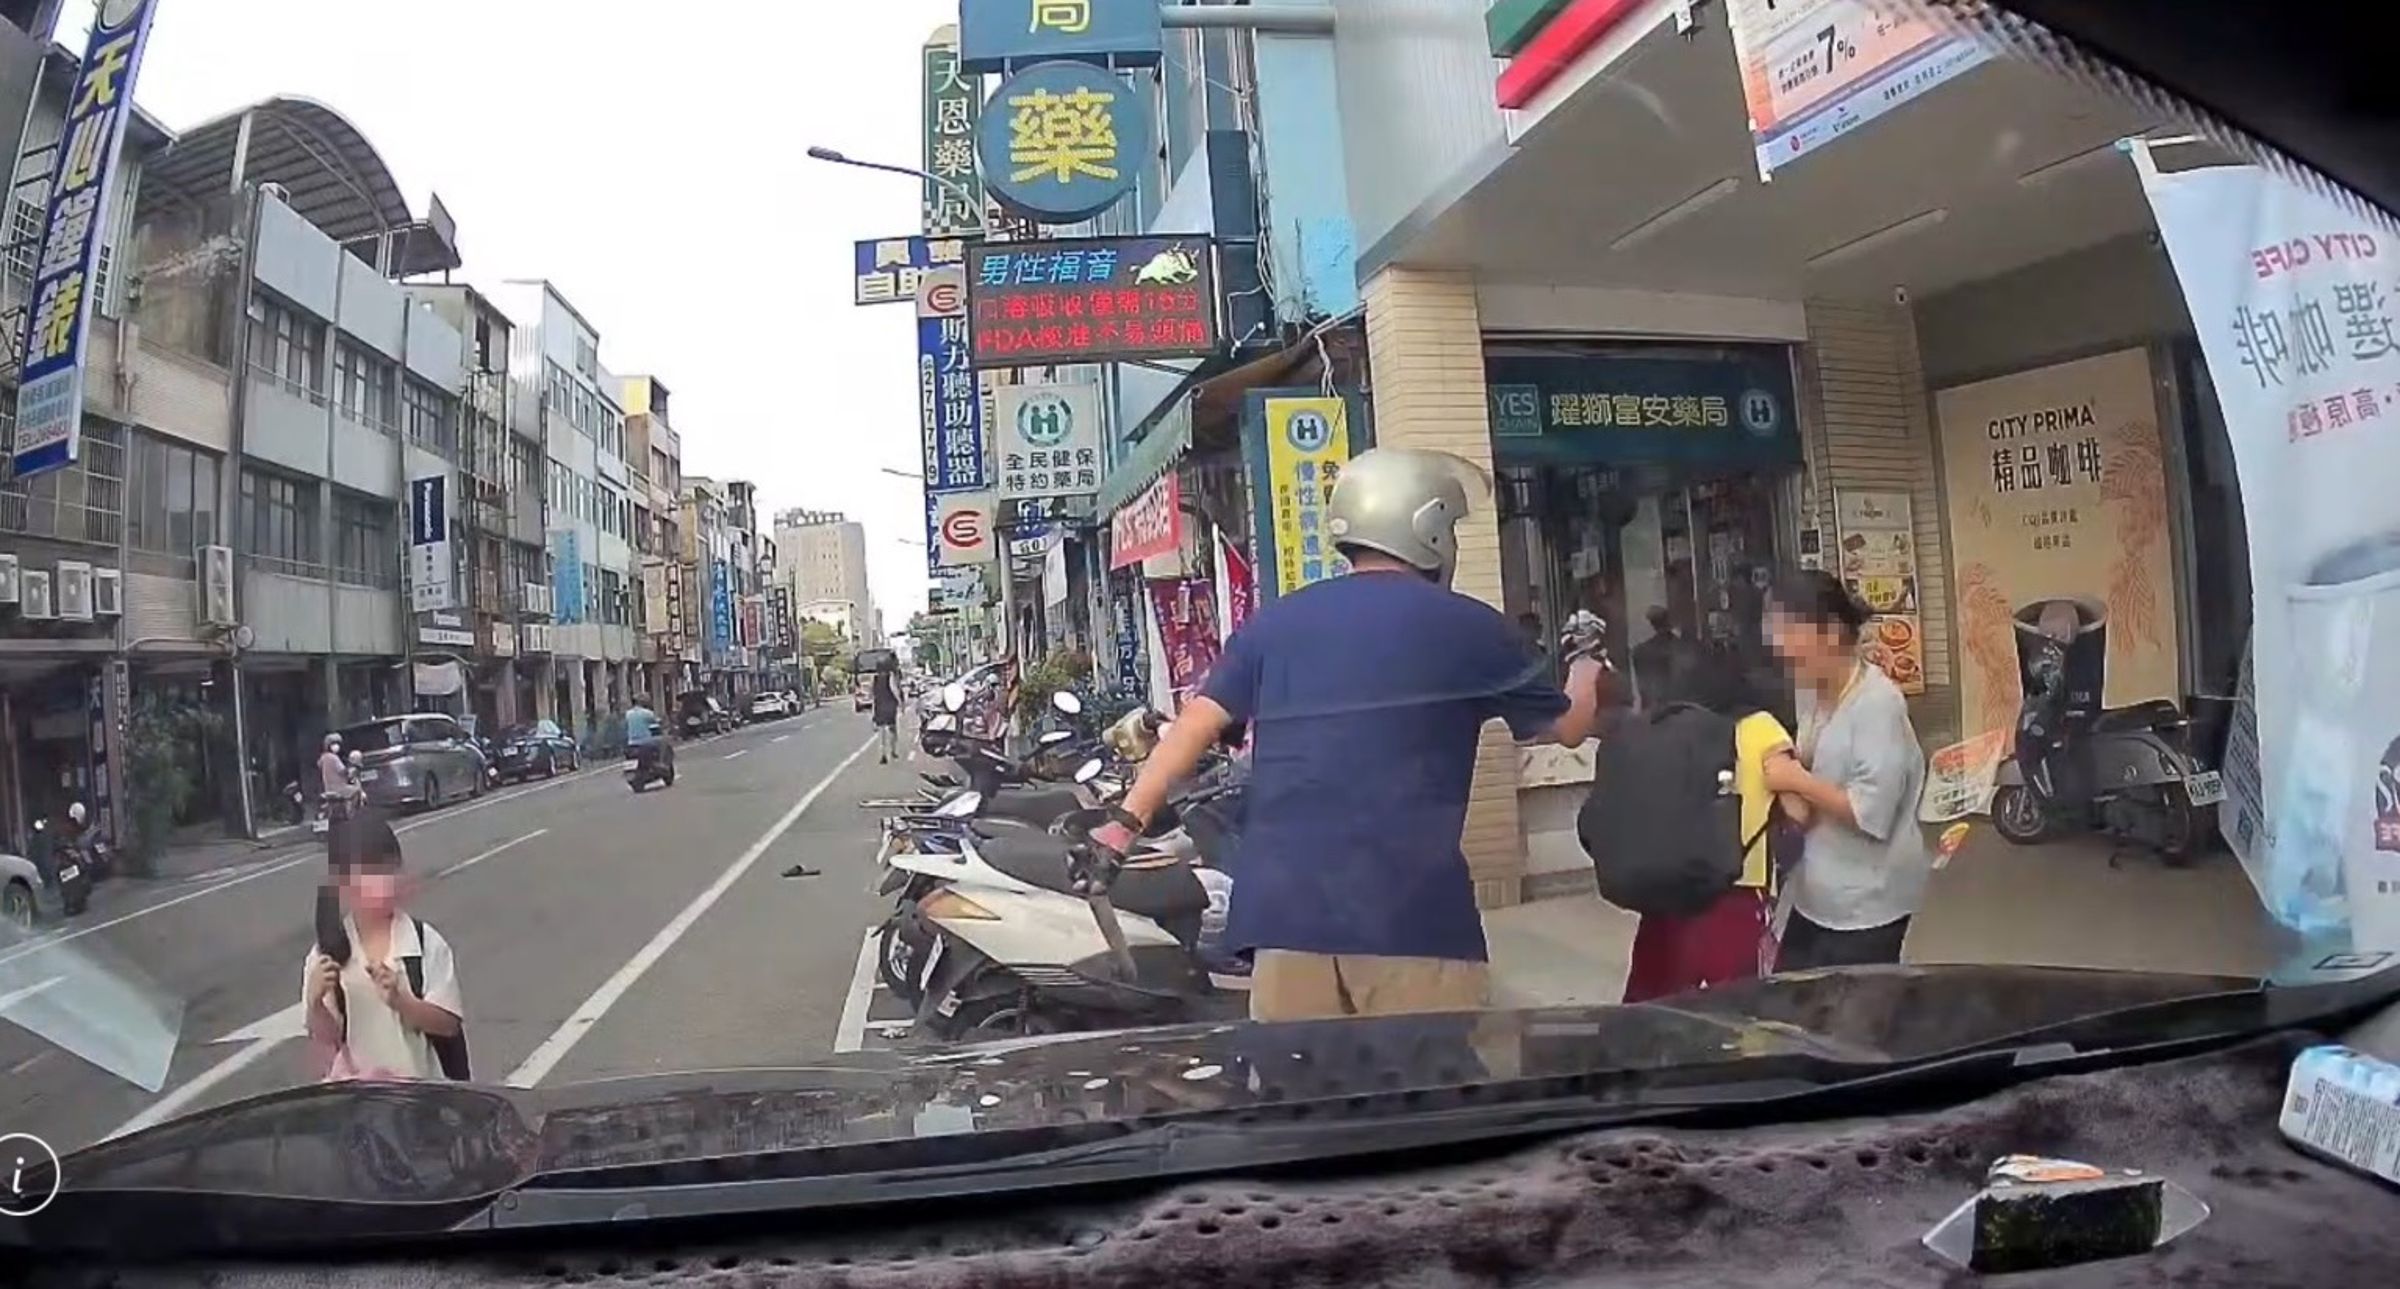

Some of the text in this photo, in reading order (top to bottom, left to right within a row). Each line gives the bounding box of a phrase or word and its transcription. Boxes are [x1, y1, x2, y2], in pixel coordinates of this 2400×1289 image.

[1008, 86, 1119, 183] 藥
[977, 248, 1117, 285] 男性福音
[1494, 392, 1535, 416] YES
[1551, 394, 1728, 427] 躍獅富安藥局
[1988, 404, 2095, 440] CITY PRIMA
[1006, 448, 1094, 472] 全民健保
[1992, 437, 2102, 492] 精品咖啡
[1006, 469, 1094, 492] 特約藥局
